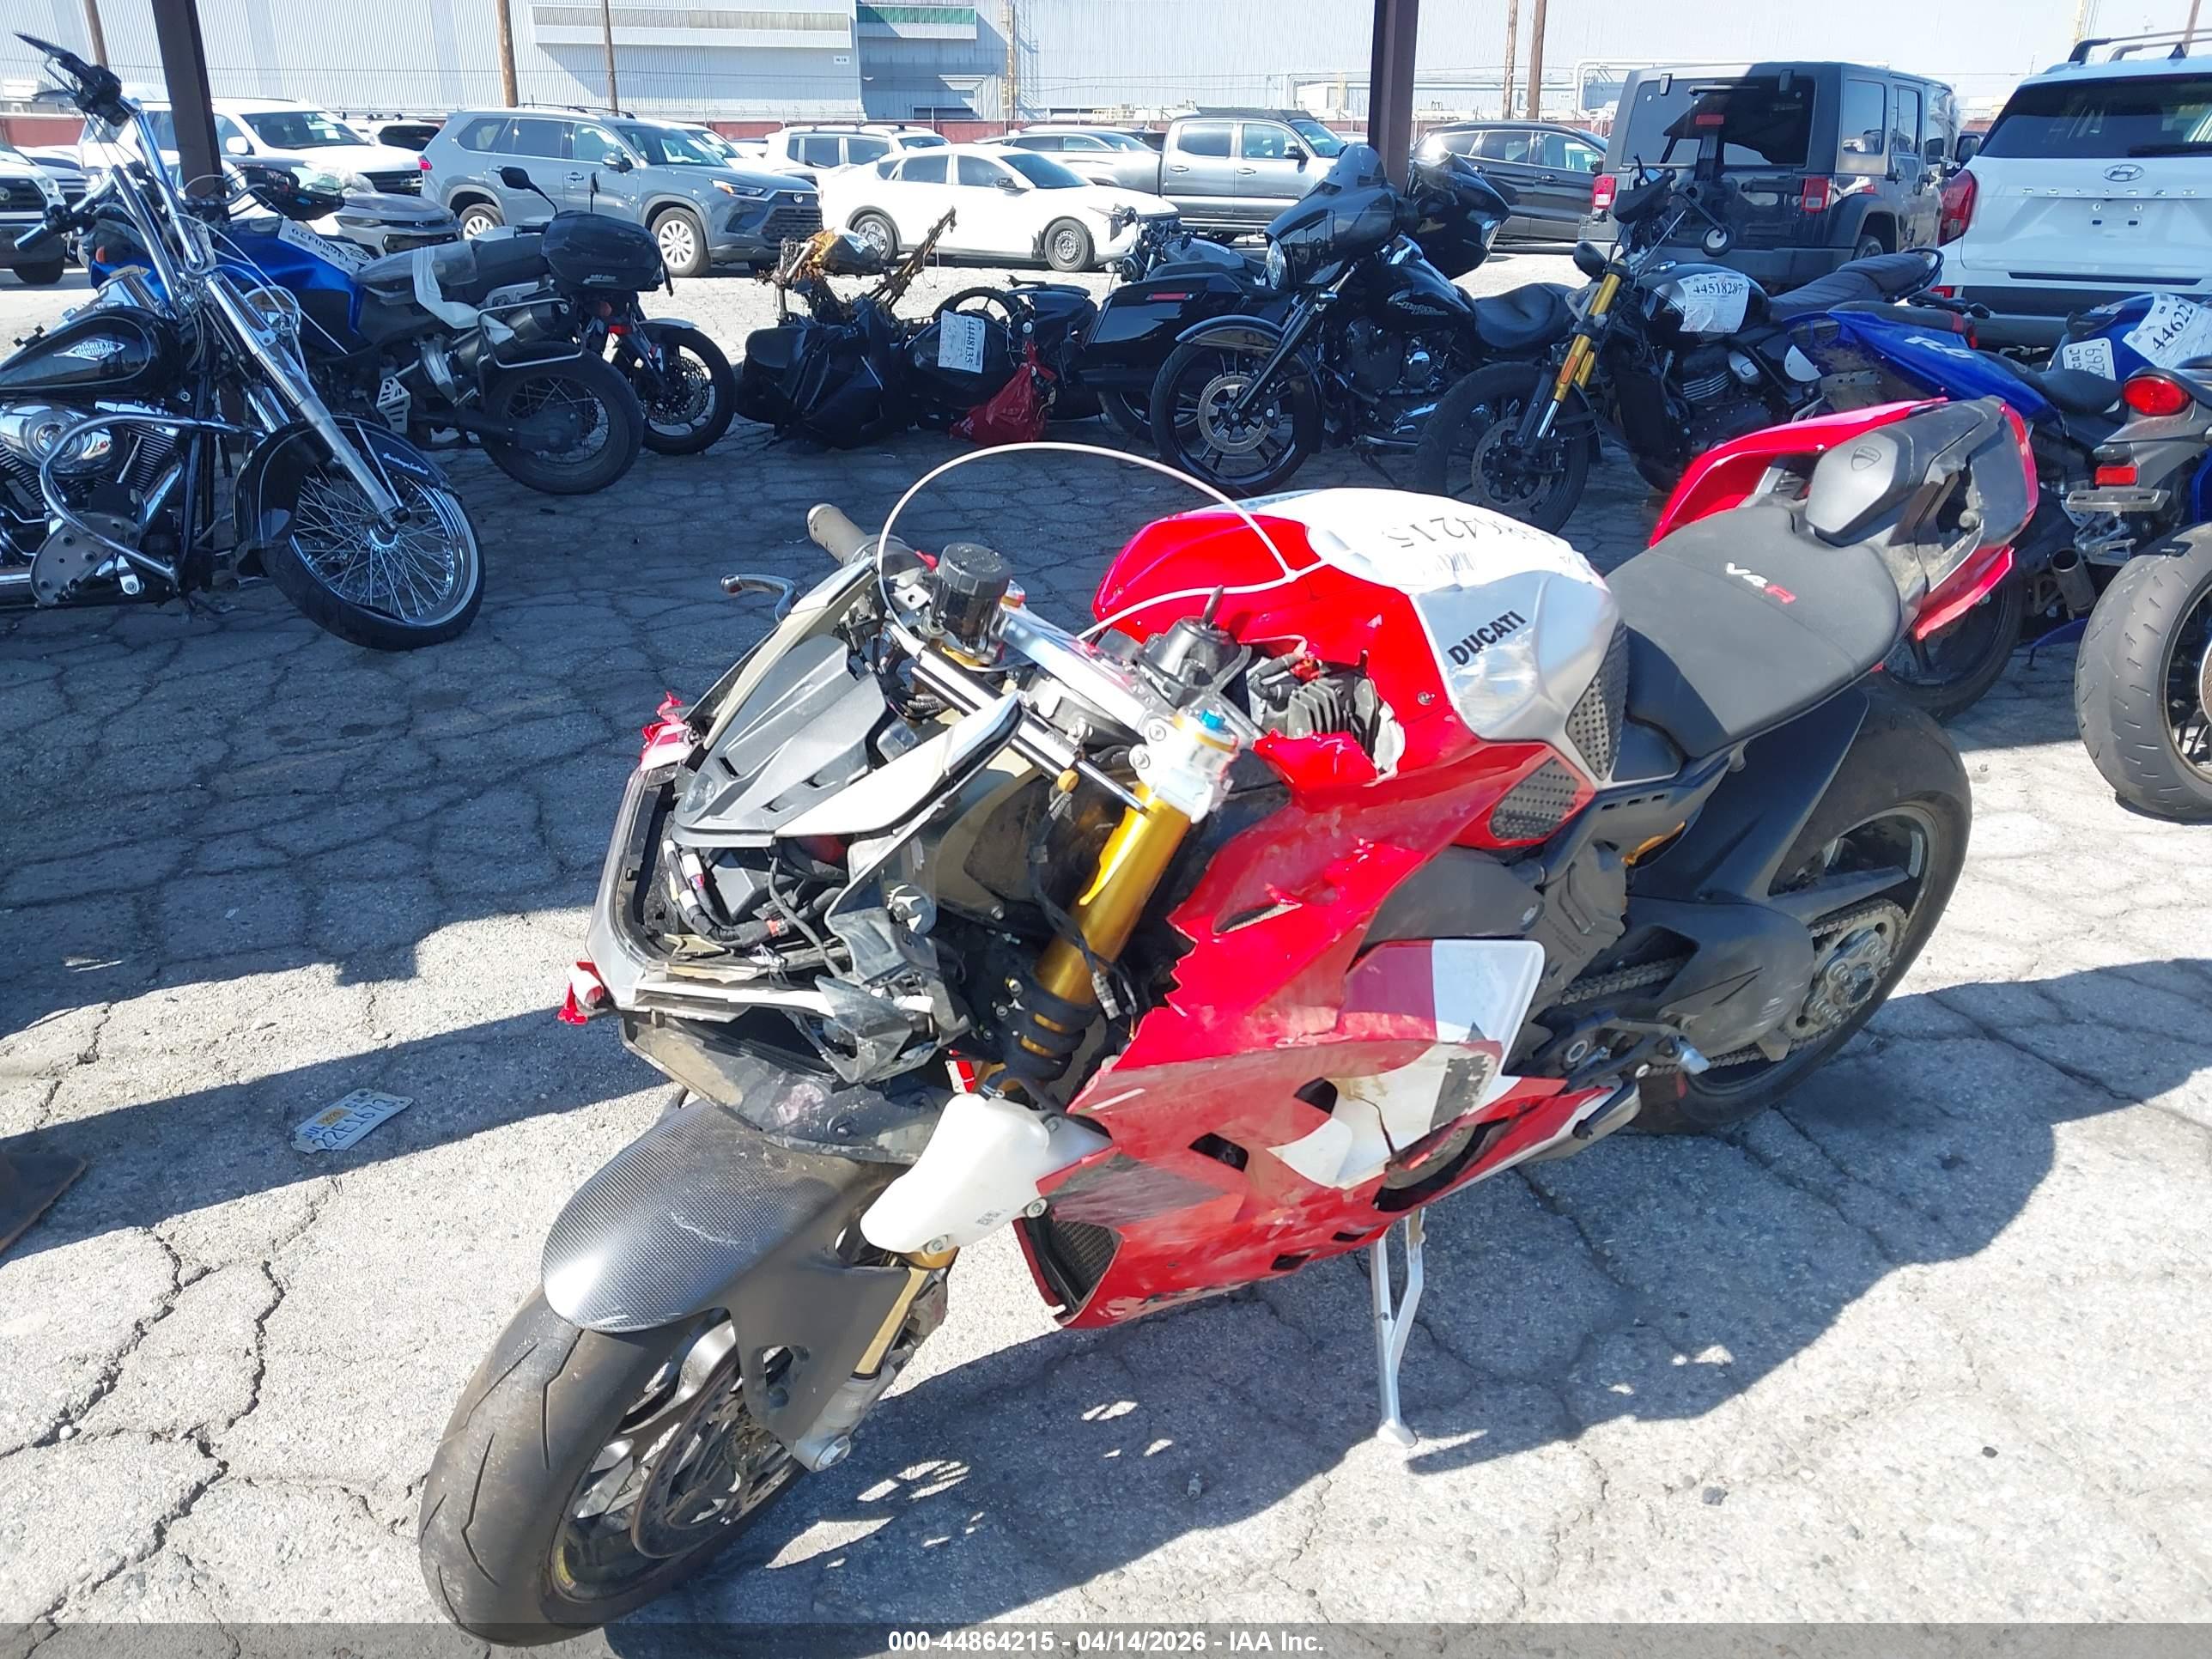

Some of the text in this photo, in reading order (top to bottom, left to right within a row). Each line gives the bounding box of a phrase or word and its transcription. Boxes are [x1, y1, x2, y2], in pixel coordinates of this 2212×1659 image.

[1693, 282, 1744, 295] 44518287
[2152, 296, 2193, 351] 44622
[1725, 562, 1797, 605] V4R
[1448, 611, 1527, 665] DUCATI
[312, 1098, 396, 1148] 22E1673
